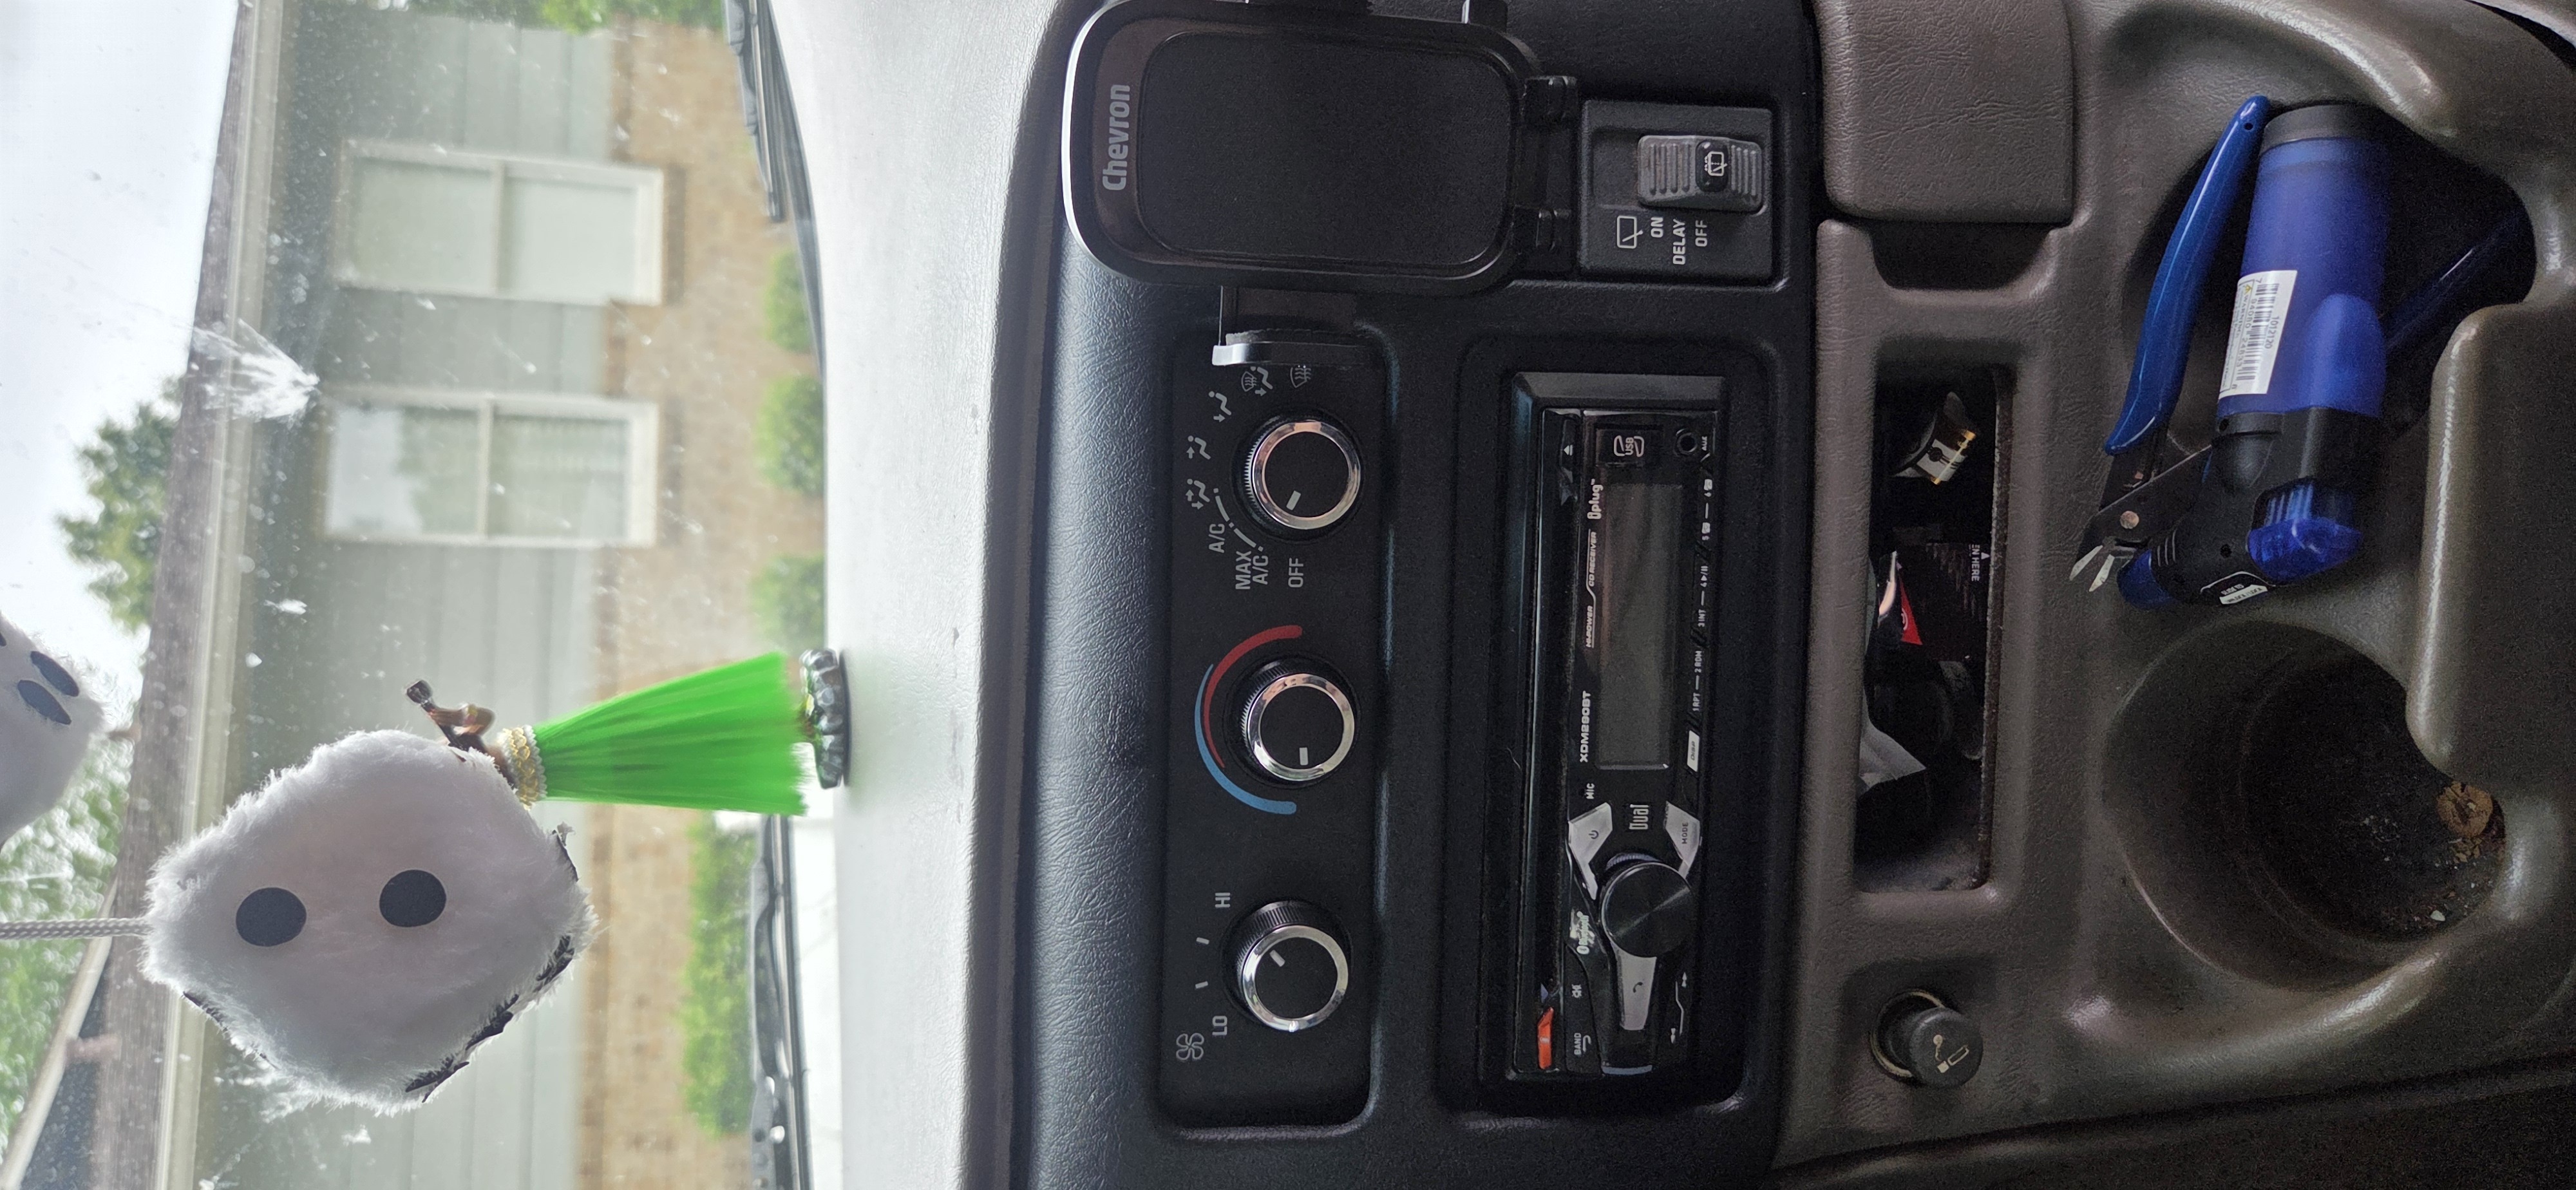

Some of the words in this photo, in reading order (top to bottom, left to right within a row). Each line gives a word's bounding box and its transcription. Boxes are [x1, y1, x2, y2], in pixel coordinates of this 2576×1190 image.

[1103, 85, 1130, 191] Chevron
[1651, 217, 1663, 238] ON
[1695, 220, 1708, 247] OFF
[1672, 219, 1686, 265] DELAY
[2264, 316, 2280, 349] 1012120
[1625, 437, 1634, 455] USB
[1209, 524, 1225, 552] A/C
[1589, 531, 1597, 573] RECEIVER
[1235, 551, 1251, 589] MAX
[1253, 555, 1269, 585] A/C
[1288, 558, 1304, 588] OFF
[1971, 557, 1980, 581] HERE
[1579, 690, 1591, 762] XDM290BT
[1586, 783, 1595, 799] MIC
[1629, 804, 1649, 830] Dual
[1215, 892, 1230, 908] HI
[1212, 1015, 1228, 1035] LO
[1573, 1032, 1582, 1055] BAND
